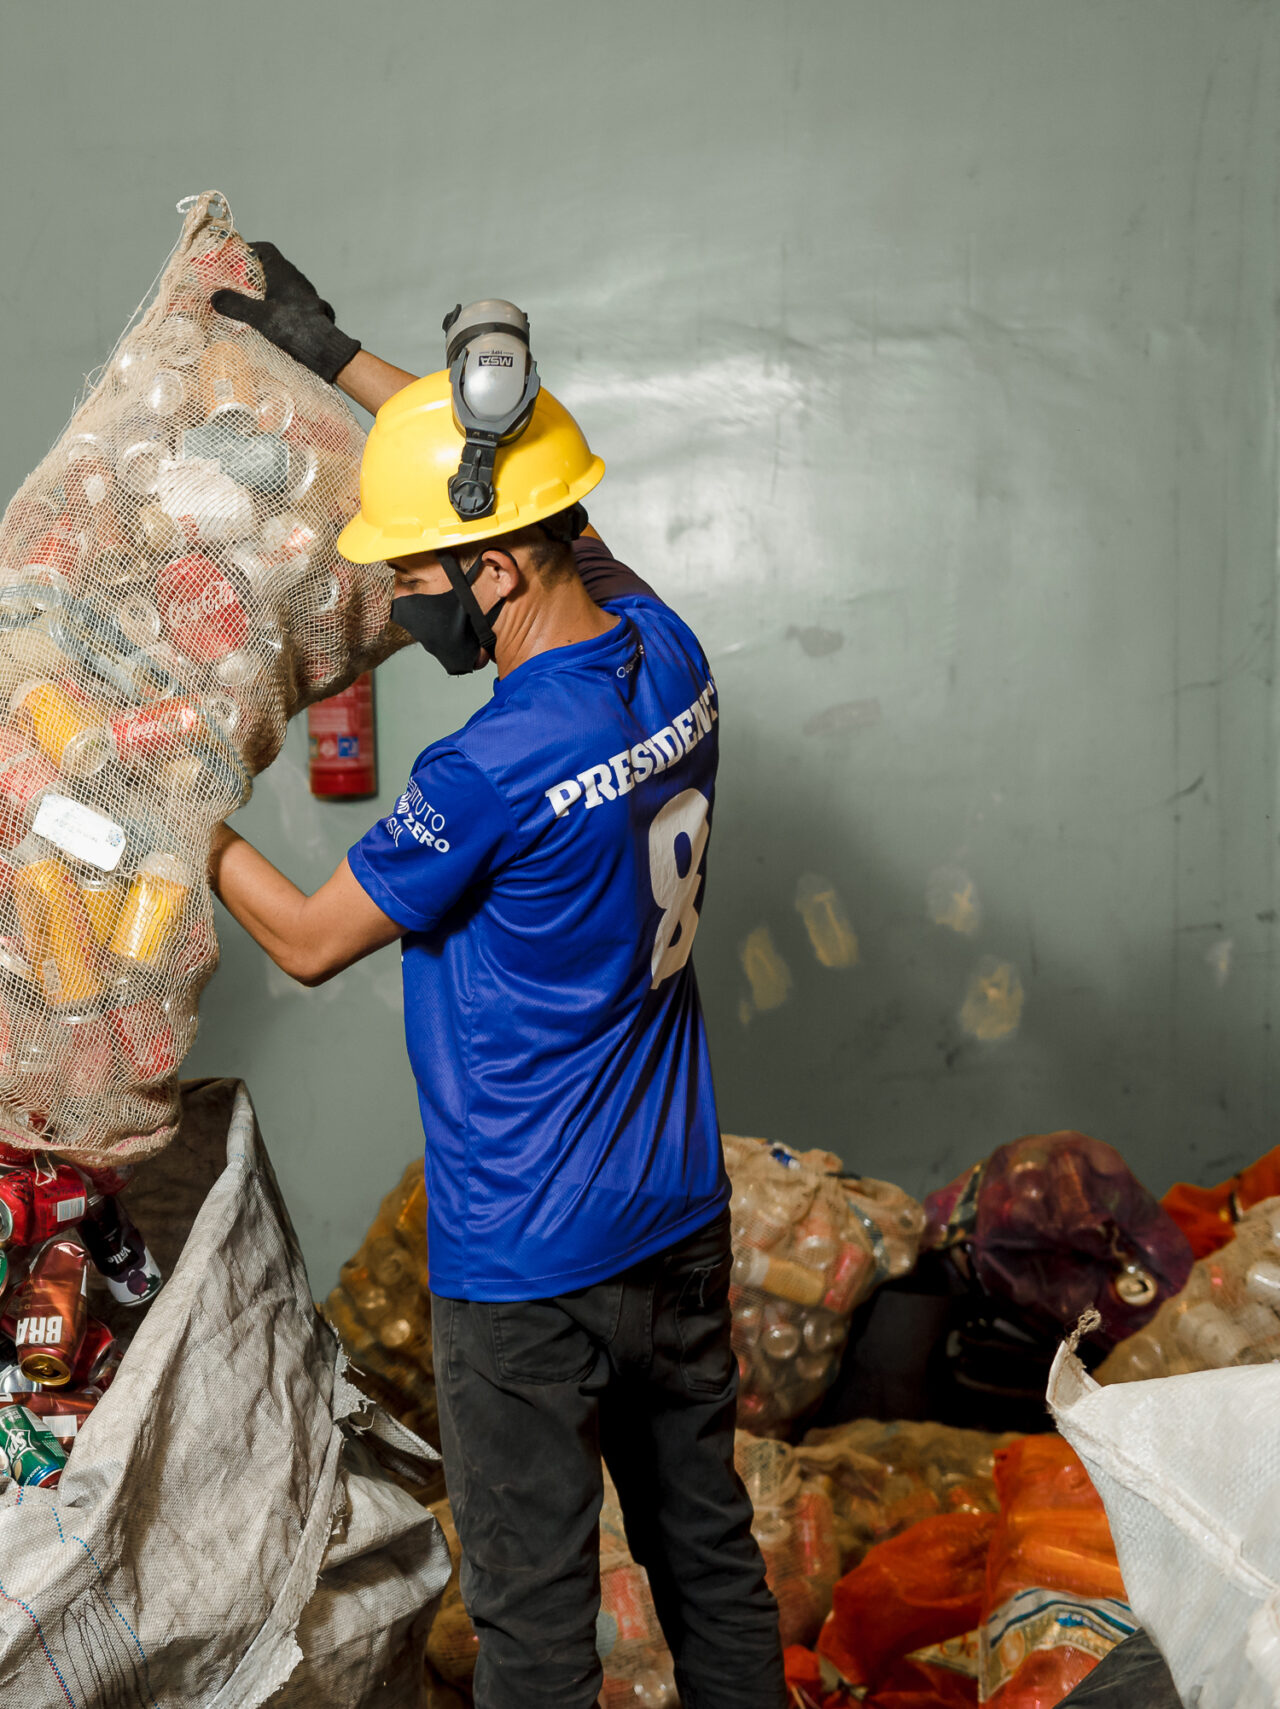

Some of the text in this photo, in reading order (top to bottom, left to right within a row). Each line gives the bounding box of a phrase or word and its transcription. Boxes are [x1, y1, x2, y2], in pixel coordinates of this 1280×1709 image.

[481, 356, 512, 366] MSA
[545, 680, 719, 819] PRESIDENT
[403, 812, 451, 853] ZERO
[648, 788, 709, 990] 8
